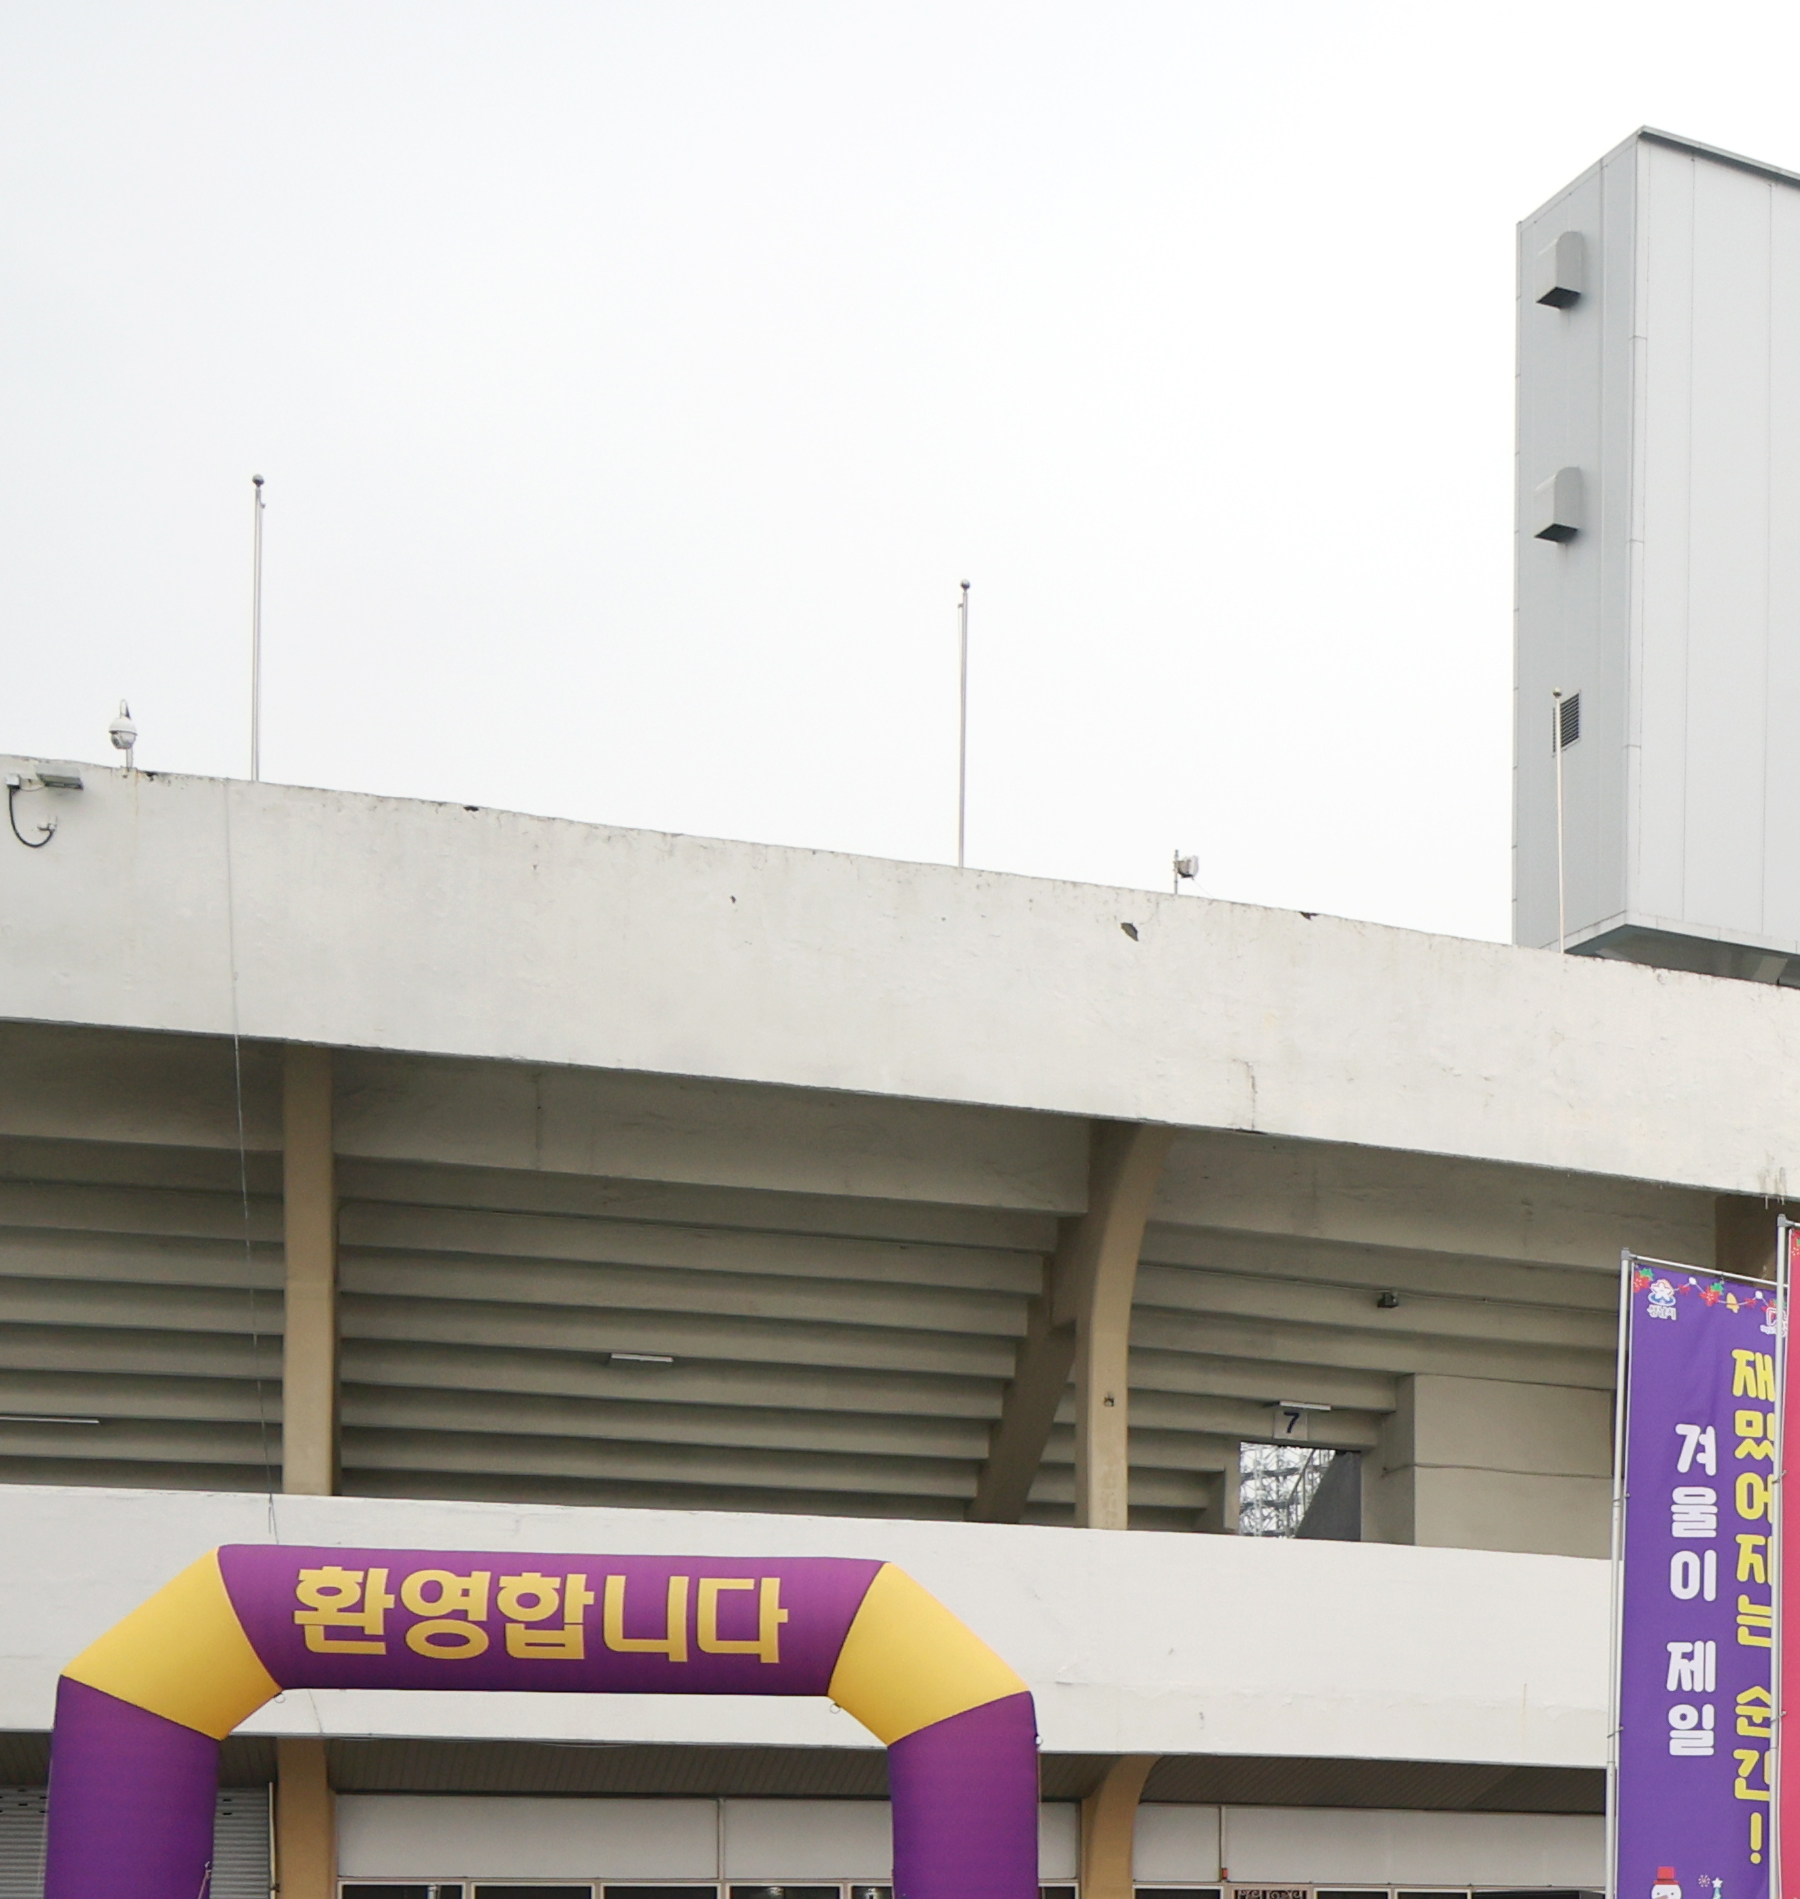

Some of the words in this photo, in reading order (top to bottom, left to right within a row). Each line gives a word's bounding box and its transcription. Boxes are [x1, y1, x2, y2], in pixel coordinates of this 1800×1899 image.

[1283, 1412, 1300, 1434] 7
[1669, 1424, 1718, 1602] 겨울이
[294, 1566, 788, 1664] 환영합니다
[1666, 1640, 1716, 1756] 제일
